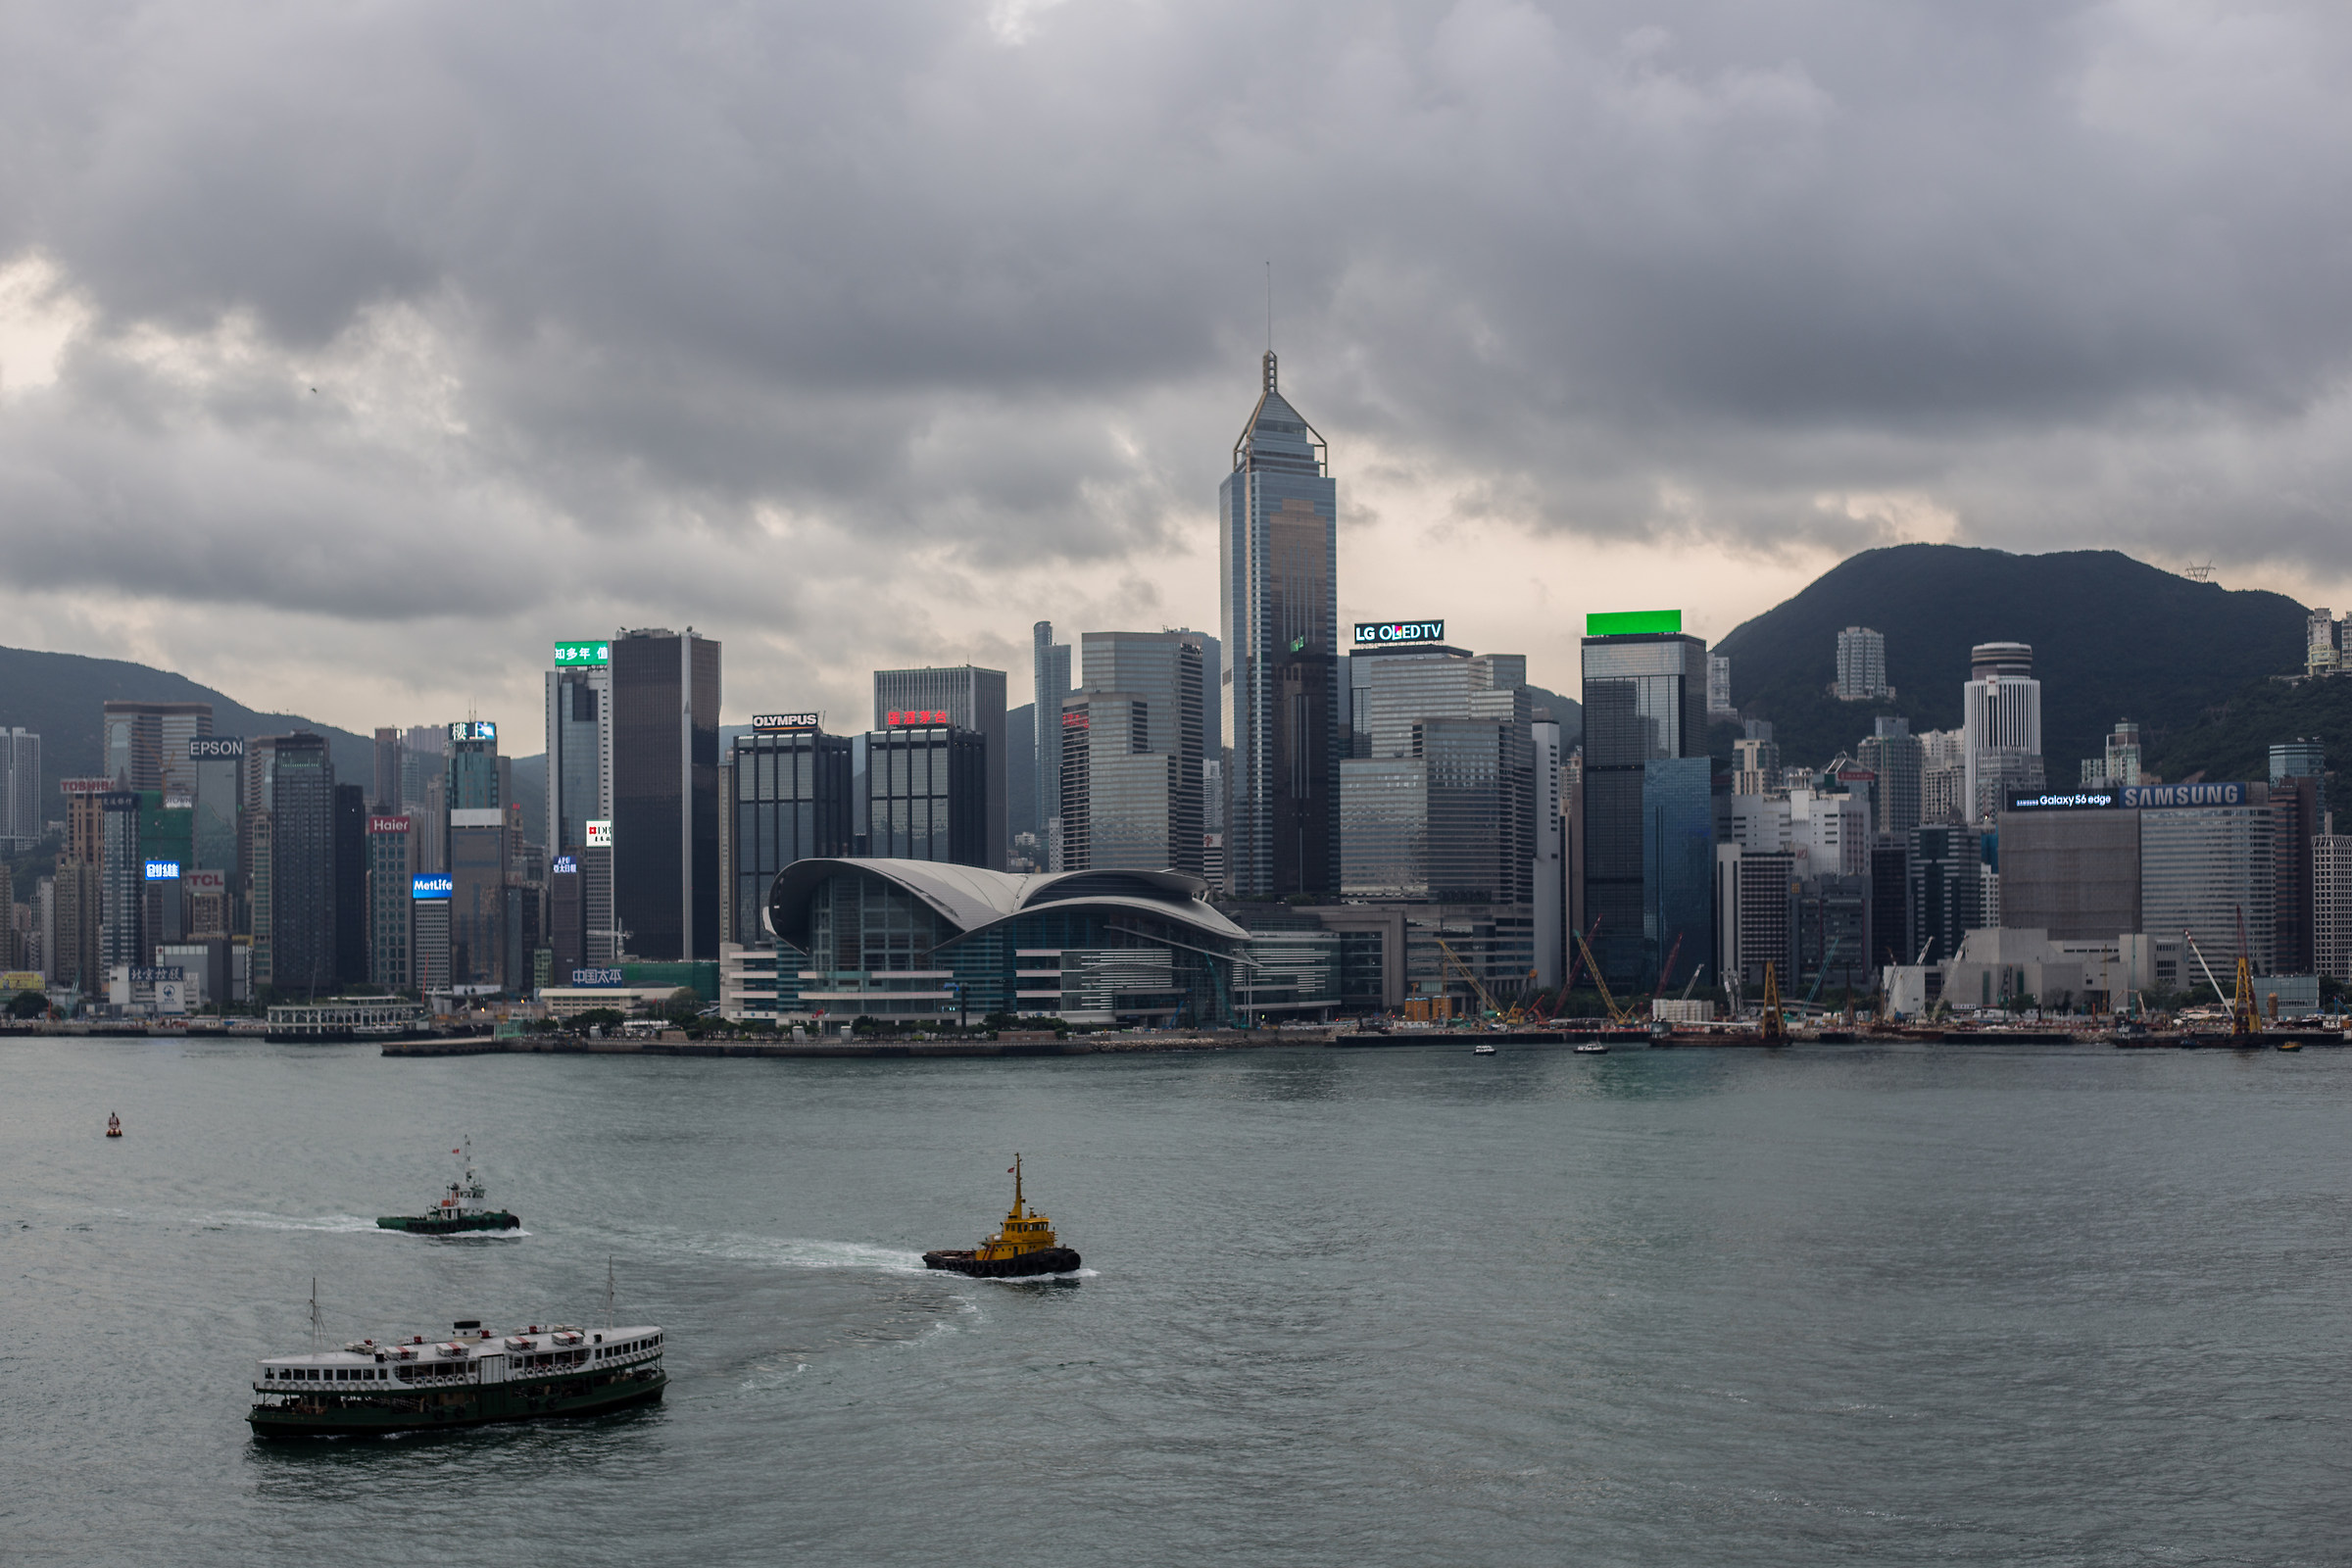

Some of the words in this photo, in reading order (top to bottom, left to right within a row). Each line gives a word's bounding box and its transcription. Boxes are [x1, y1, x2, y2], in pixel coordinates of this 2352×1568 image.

[1355, 627, 1376, 641] LG
[753, 714, 817, 727] OLYMPUS
[190, 741, 243, 755] EPSON
[2039, 795, 2074, 807] Galaxy
[2075, 795, 2087, 804] S6
[2087, 795, 2112, 806] edge
[2125, 785, 2238, 808] SAMSUNG
[373, 819, 409, 831] Haier
[189, 874, 223, 886] TCL
[414, 879, 453, 891] MetLife
[572, 968, 622, 984] 中国太平
